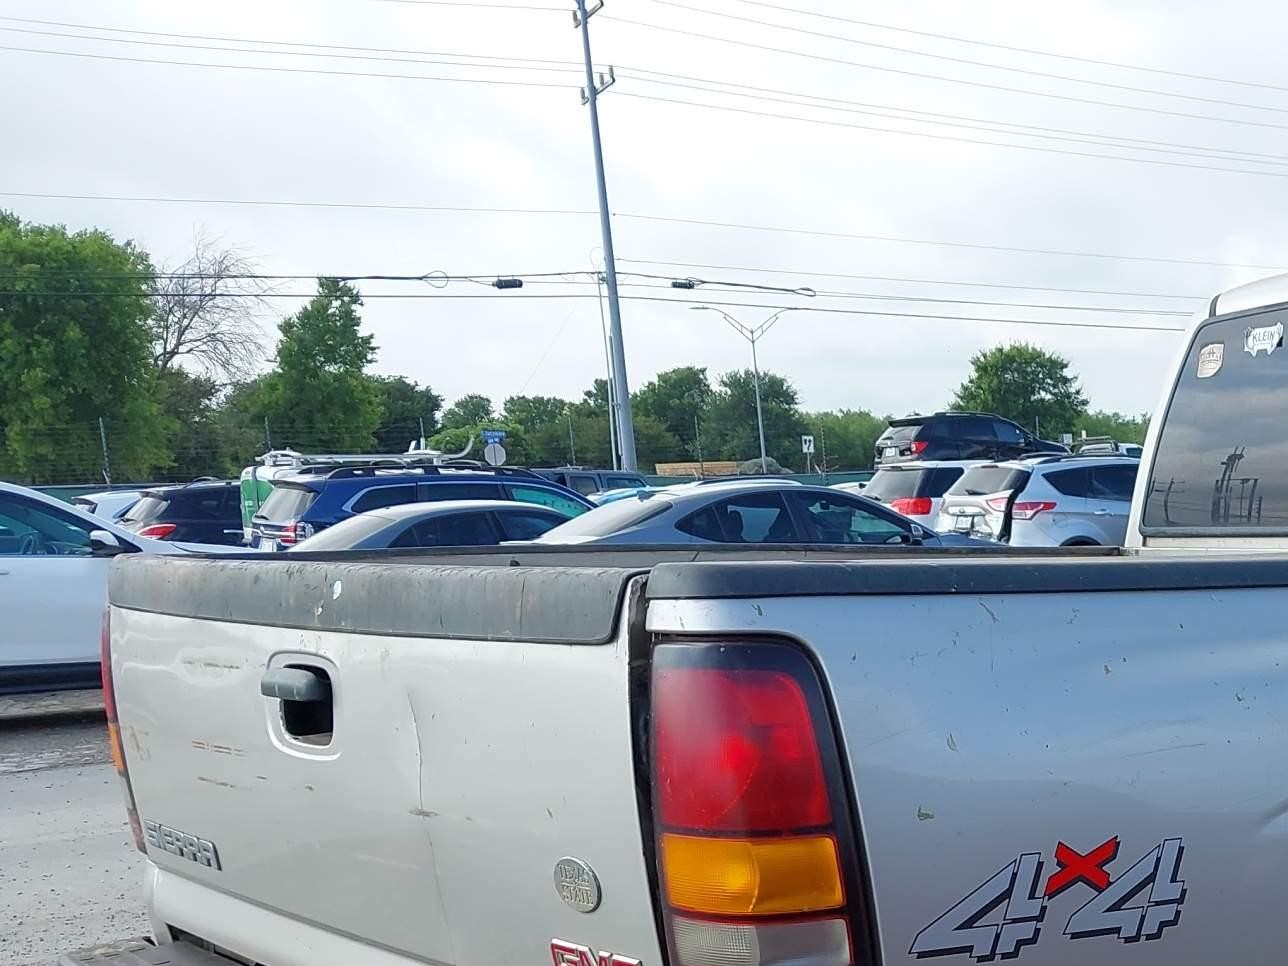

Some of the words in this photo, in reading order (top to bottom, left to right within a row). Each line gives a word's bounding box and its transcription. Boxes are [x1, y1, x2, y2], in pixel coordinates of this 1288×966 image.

[1252, 329, 1275, 342] KLEIN
[143, 819, 222, 871] SIERRA
[561, 885, 594, 906] STATE
